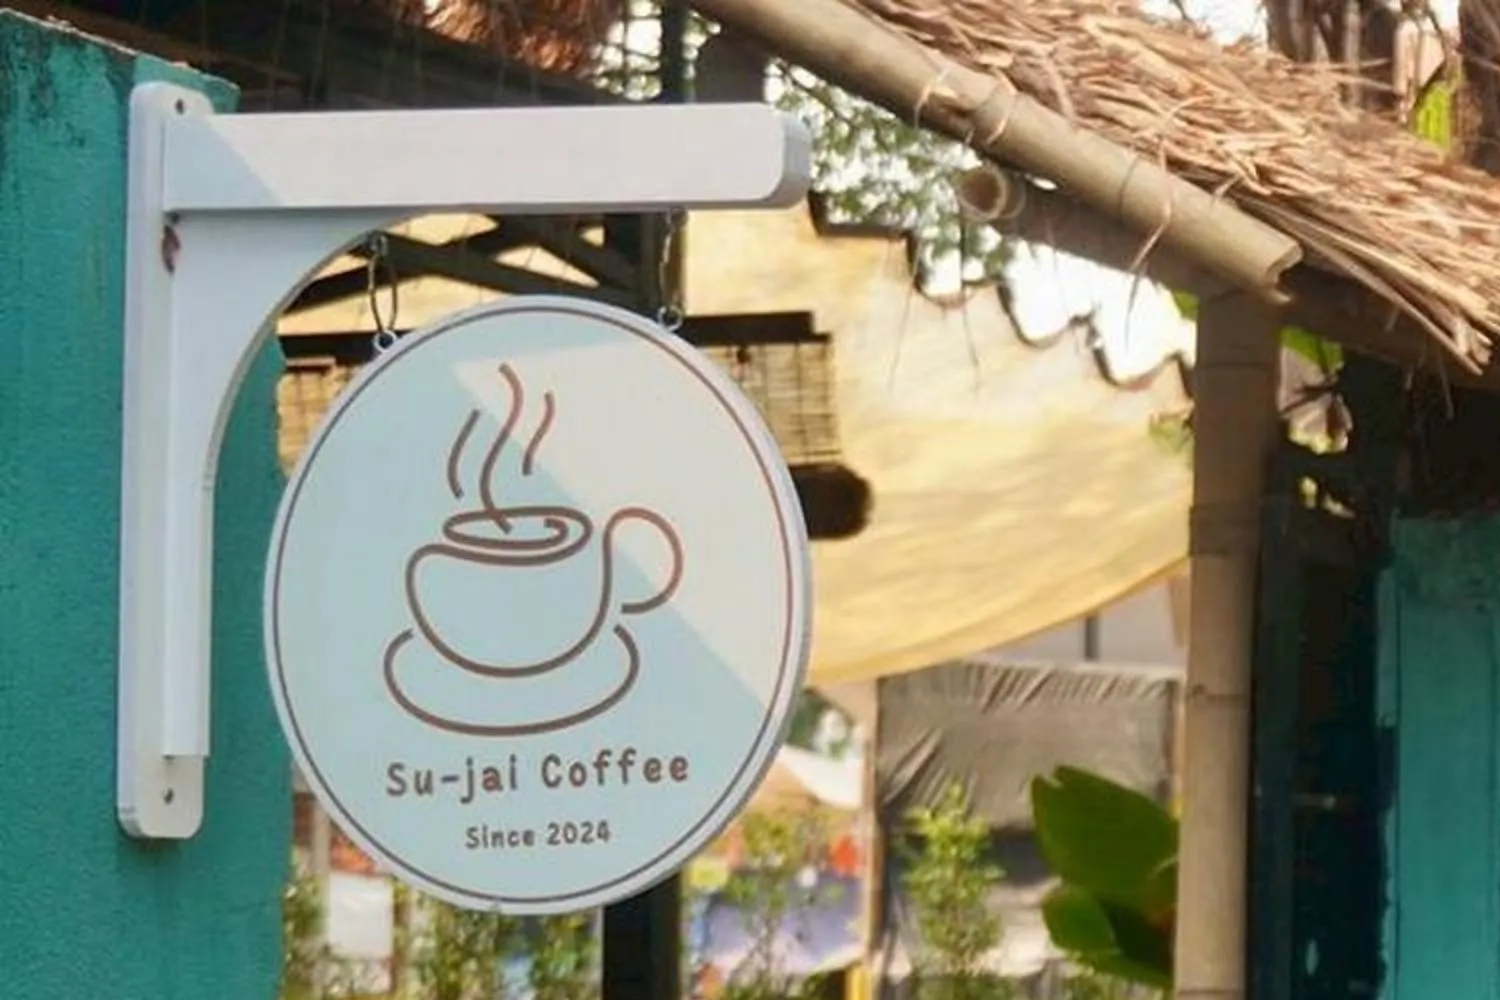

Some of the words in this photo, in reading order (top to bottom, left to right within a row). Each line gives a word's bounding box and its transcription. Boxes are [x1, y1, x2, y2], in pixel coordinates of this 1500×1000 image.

[386, 754, 518, 805] Su-jai
[540, 748, 690, 789] Coffee
[465, 824, 536, 849] Since
[546, 820, 612, 846] 2024
